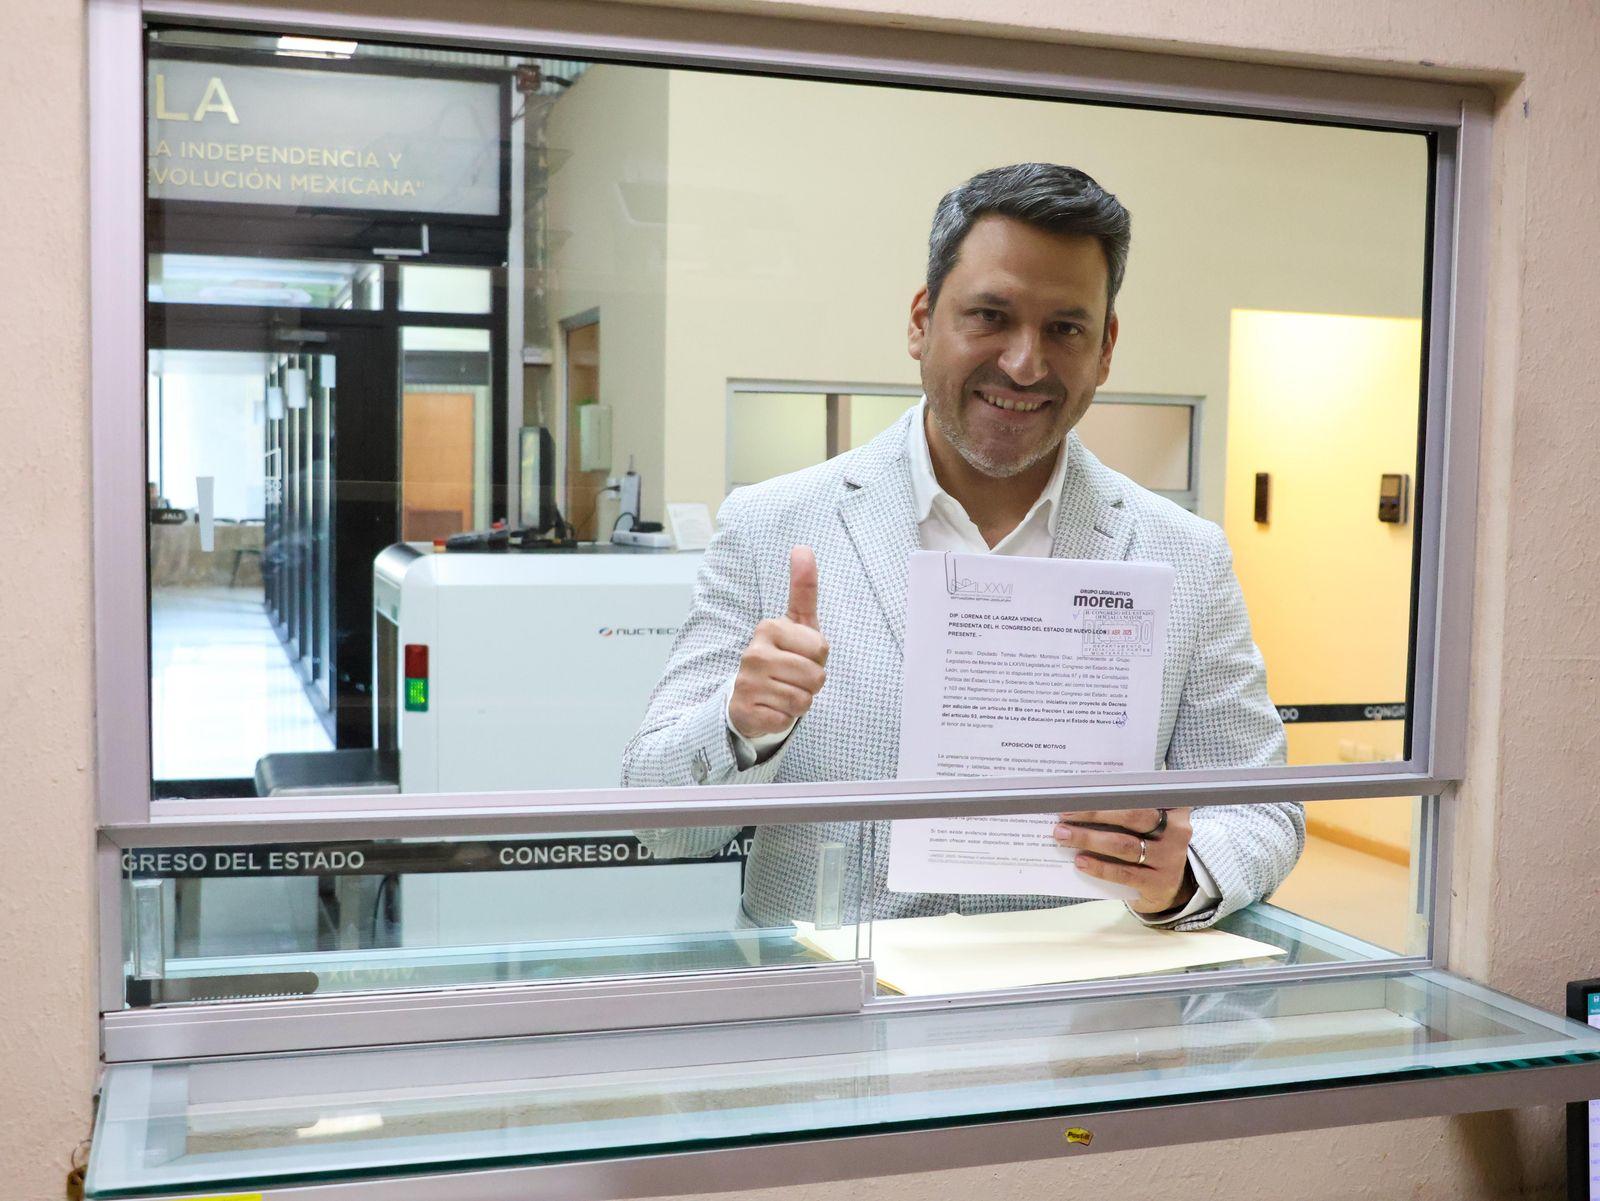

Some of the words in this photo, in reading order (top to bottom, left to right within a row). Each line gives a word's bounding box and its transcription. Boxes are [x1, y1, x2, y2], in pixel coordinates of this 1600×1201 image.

[156, 74, 239, 124] LA
[149, 140, 172, 158] A
[181, 141, 380, 169] INDEPENDENCIA
[389, 153, 402, 170] Y
[149, 168, 282, 190] VOLUCIÓN
[1073, 595, 1134, 609] morena
[616, 628, 678, 636] NUCTEC
[214, 852, 262, 870] DEL
[269, 851, 364, 870] ESTADO
[500, 844, 629, 864] CONGRESO
